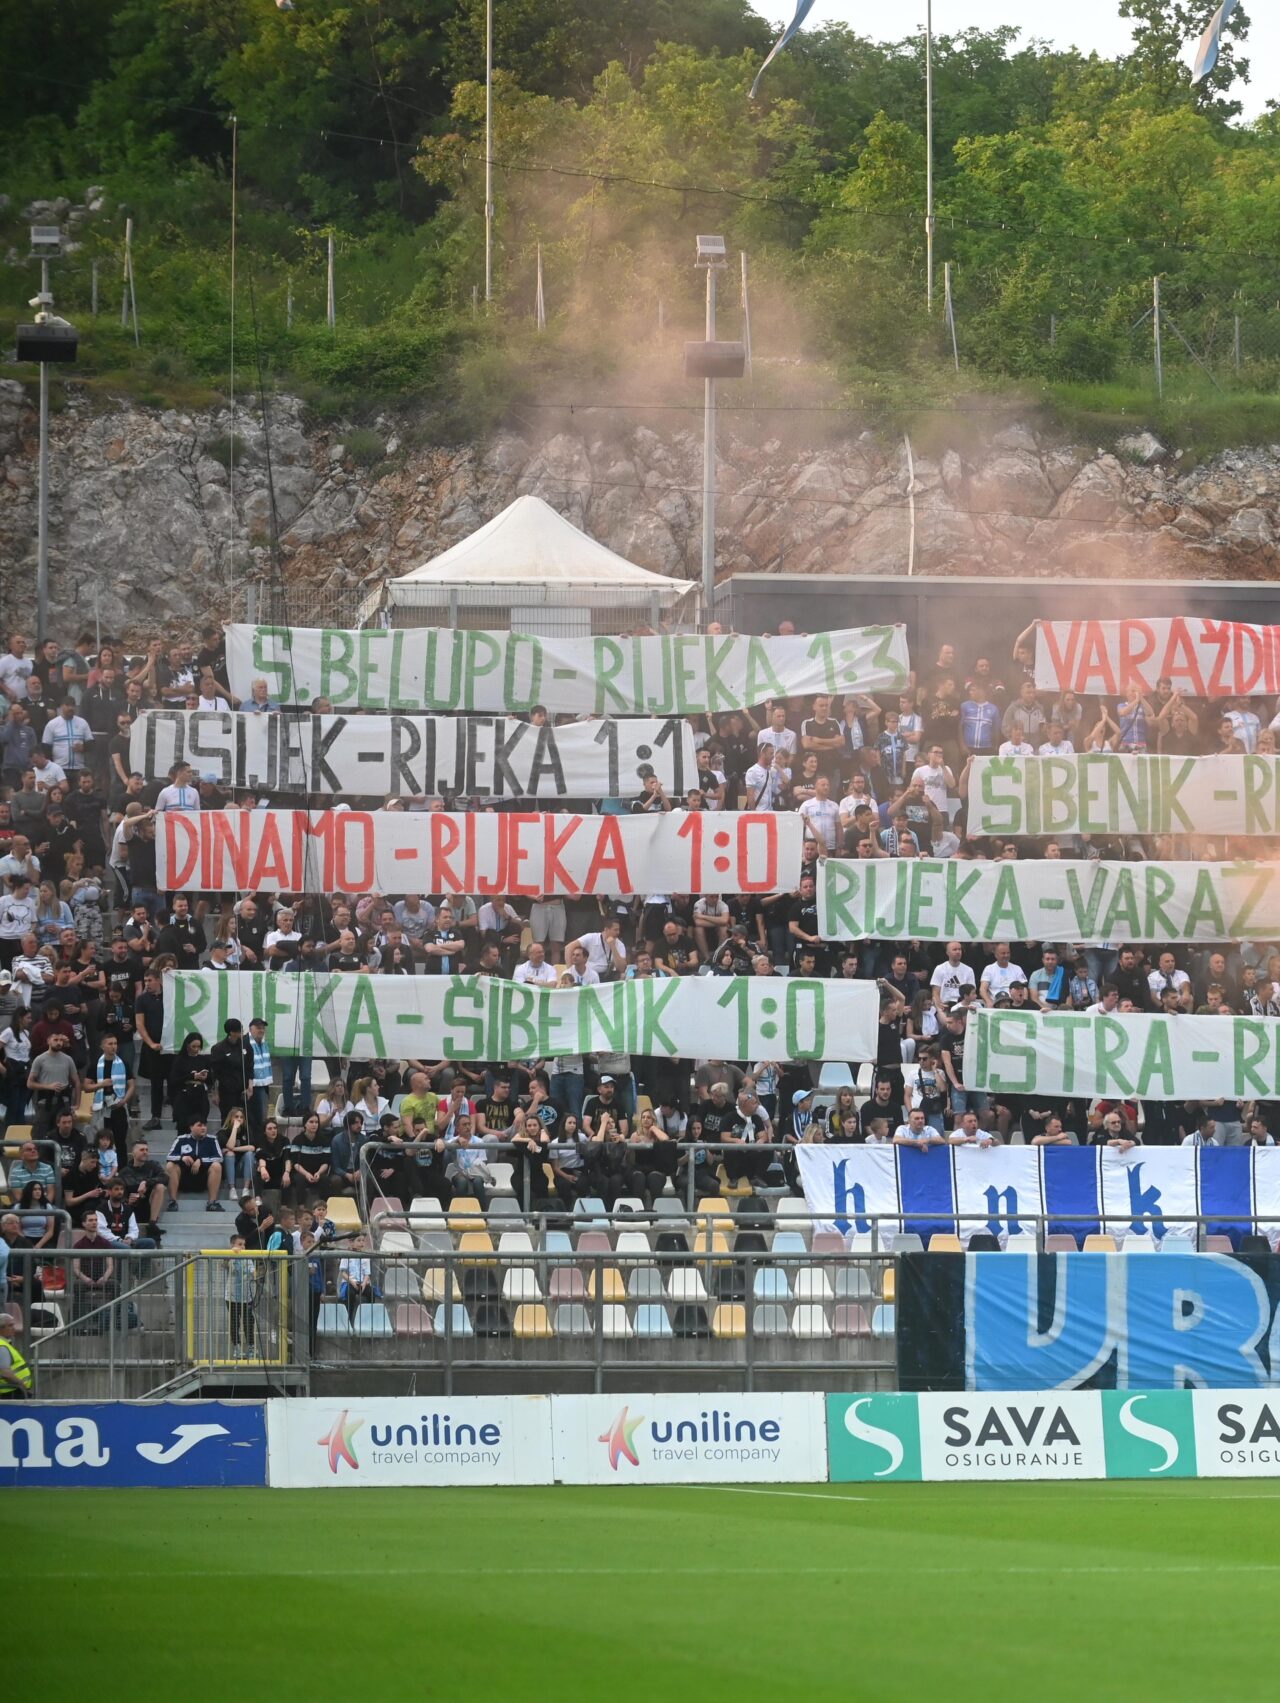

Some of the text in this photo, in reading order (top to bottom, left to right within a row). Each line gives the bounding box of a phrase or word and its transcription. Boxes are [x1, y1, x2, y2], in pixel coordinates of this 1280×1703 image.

[807, 626, 908, 694] 1:3
[594, 719, 683, 796] 1:1
[677, 811, 778, 893] 1:0
[717, 976, 826, 1059] 1:0
[371, 1413, 500, 1447] uniline
[651, 1410, 781, 1443] uniline
[943, 1406, 1081, 1446] SAVA
[372, 1450, 501, 1470] travel company
[652, 1446, 781, 1463] travel company
[945, 1452, 1083, 1467] OSIGURANJE
